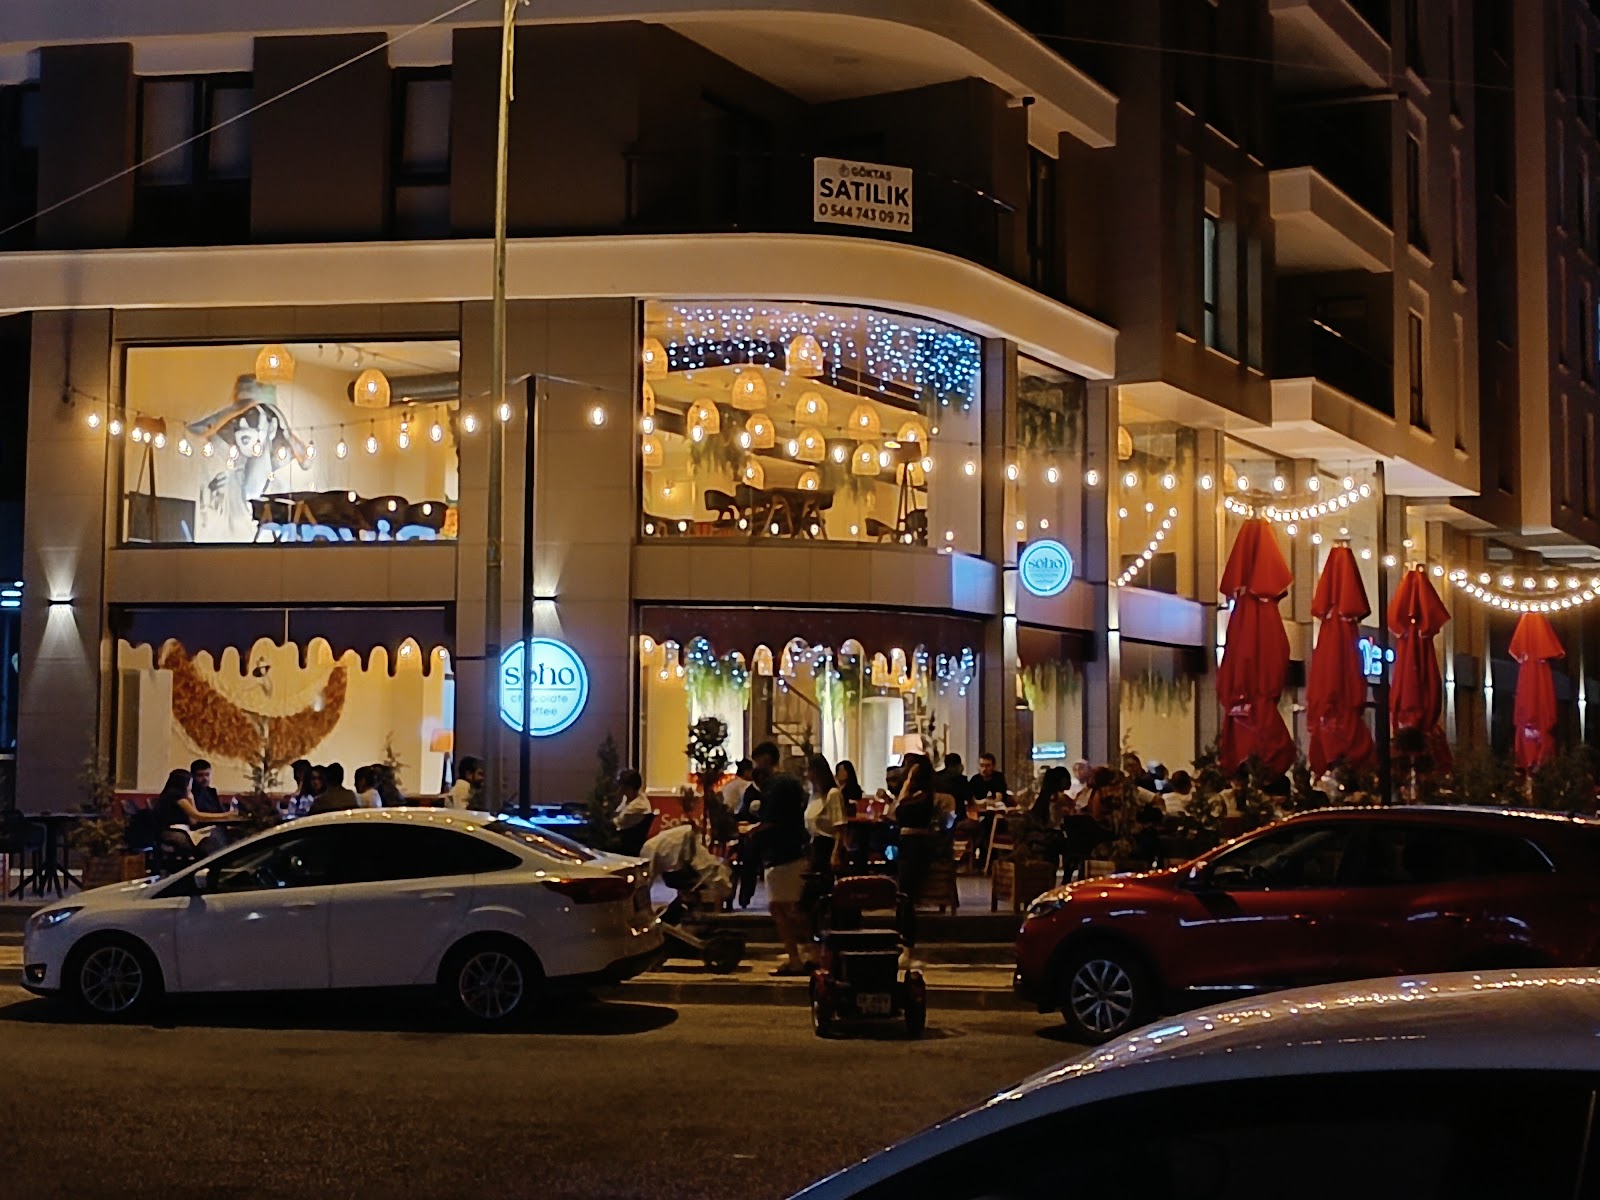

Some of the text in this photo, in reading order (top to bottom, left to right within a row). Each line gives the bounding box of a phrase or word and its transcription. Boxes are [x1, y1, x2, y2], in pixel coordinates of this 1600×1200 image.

[820, 178, 909, 207] SATILIK
[818, 203, 910, 225] 0 544 743 09 72
